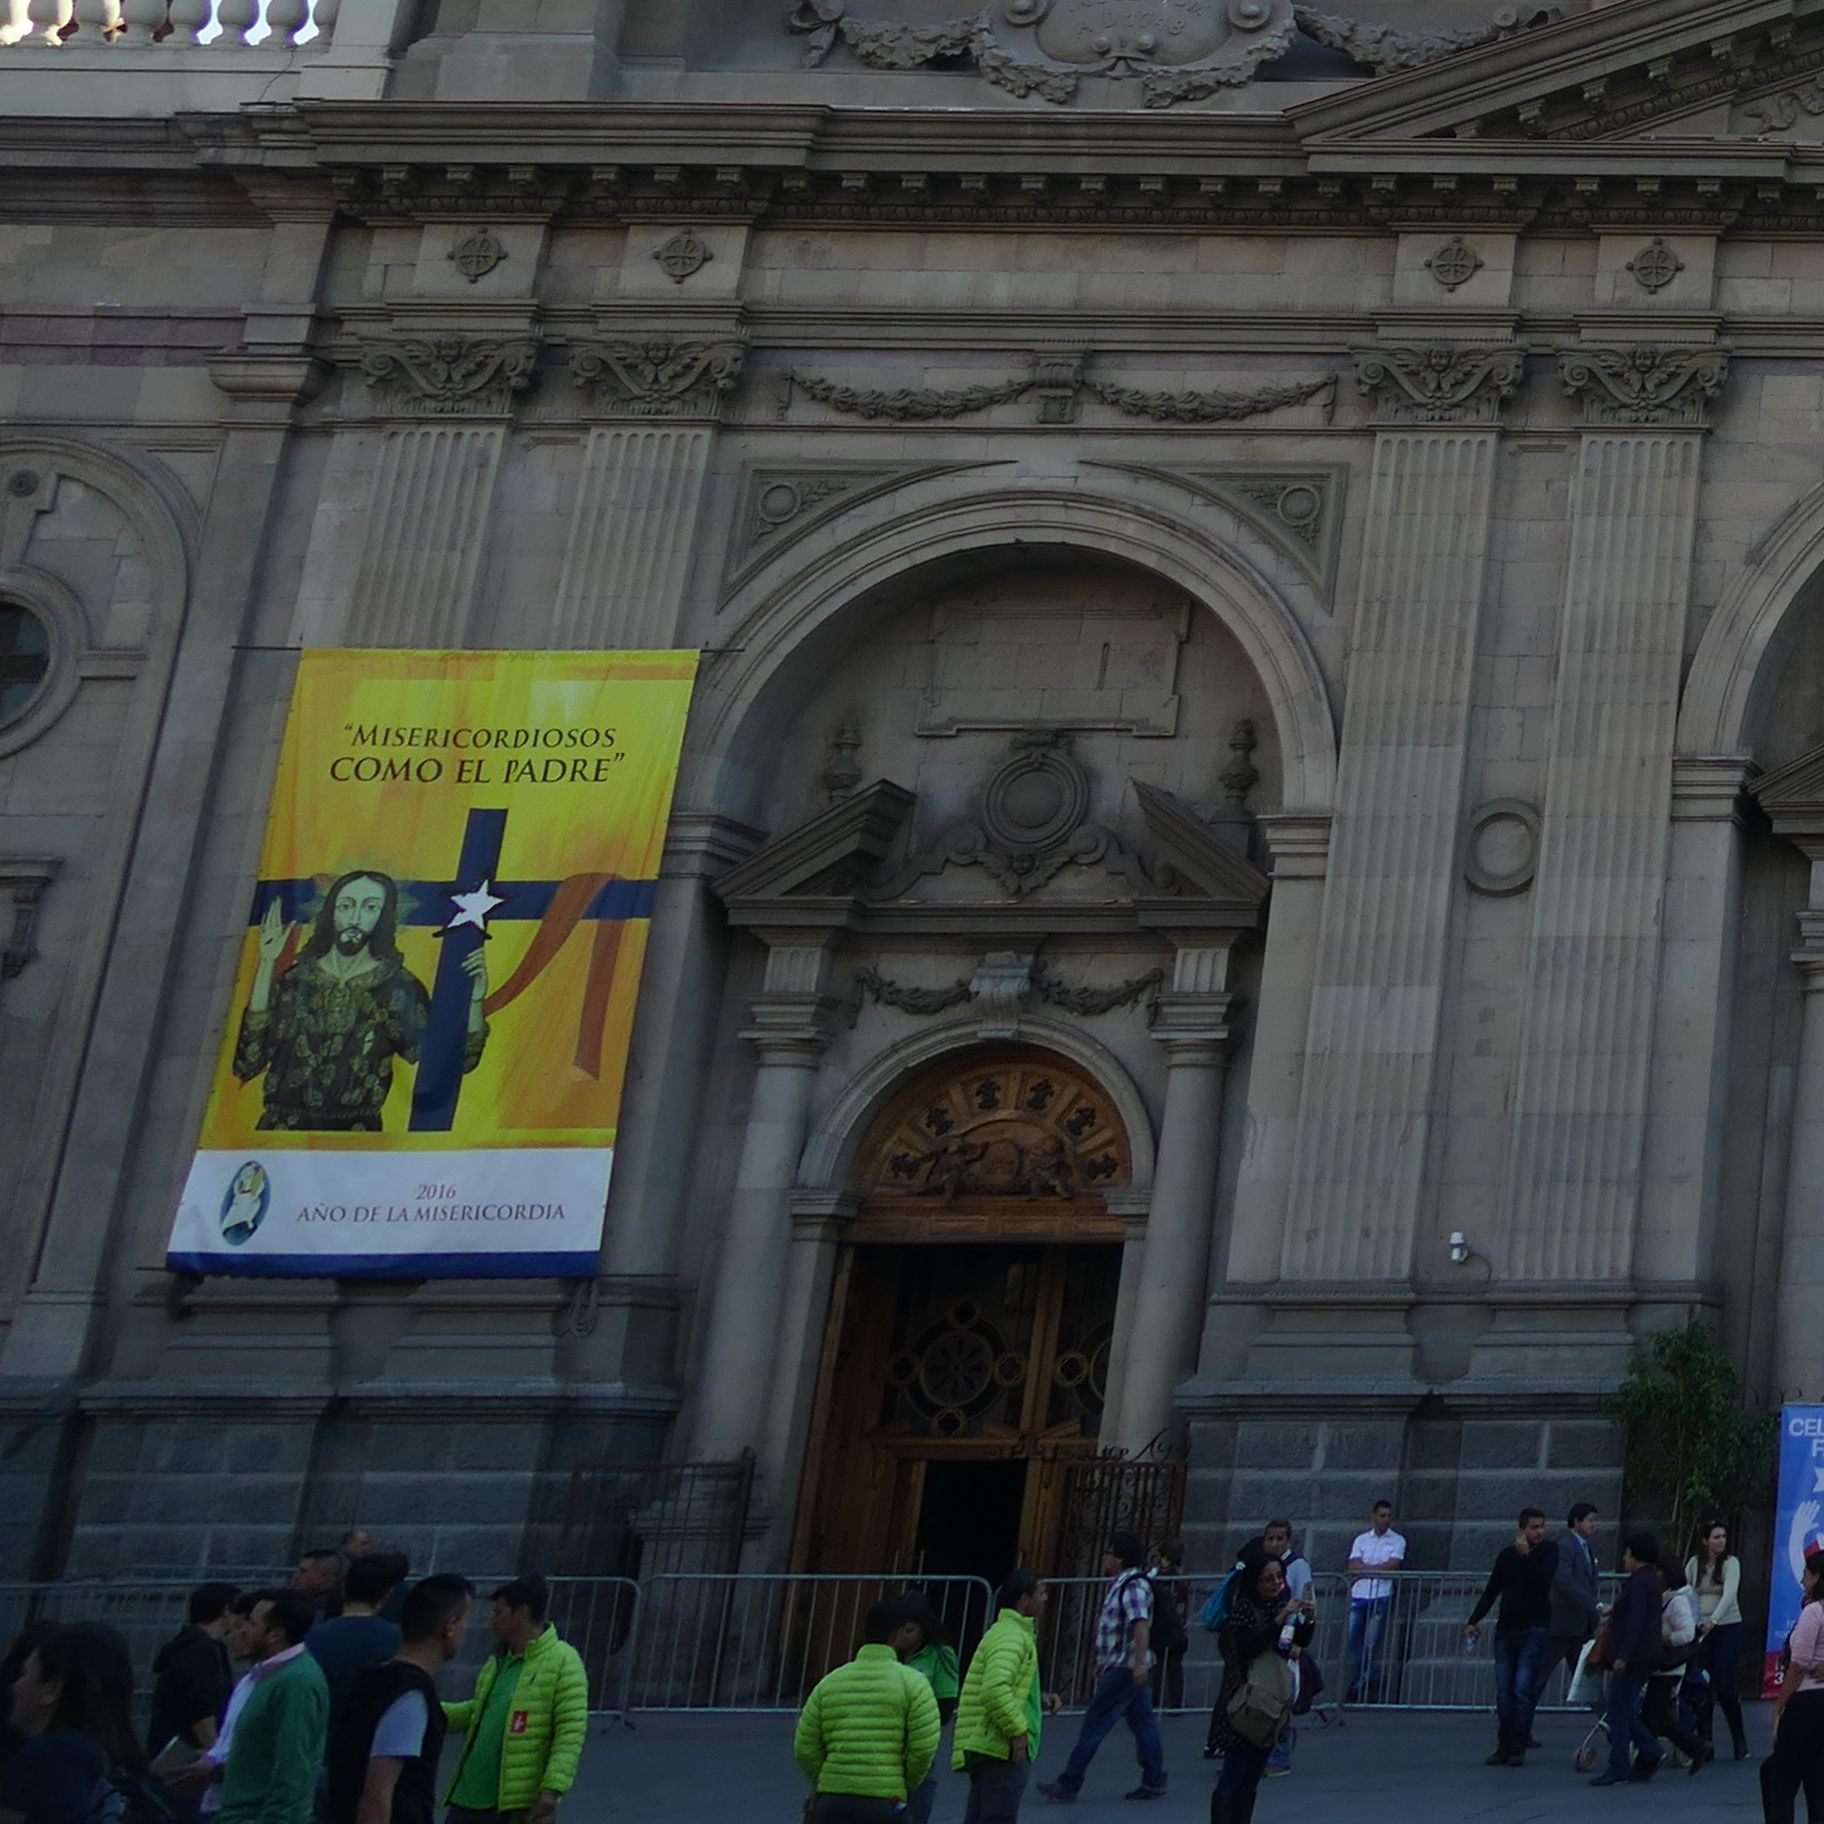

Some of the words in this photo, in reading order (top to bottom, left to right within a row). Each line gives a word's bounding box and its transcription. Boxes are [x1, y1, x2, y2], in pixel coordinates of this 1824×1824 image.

[330, 757, 443, 782] COMO
[456, 758, 490, 784] EL
[416, 1184, 457, 1200] 2016
[297, 1202, 346, 1222] AÑO
[353, 1205, 382, 1222] DE
[386, 1205, 409, 1222] LA
[414, 1203, 566, 1222] MISERICORDIA
